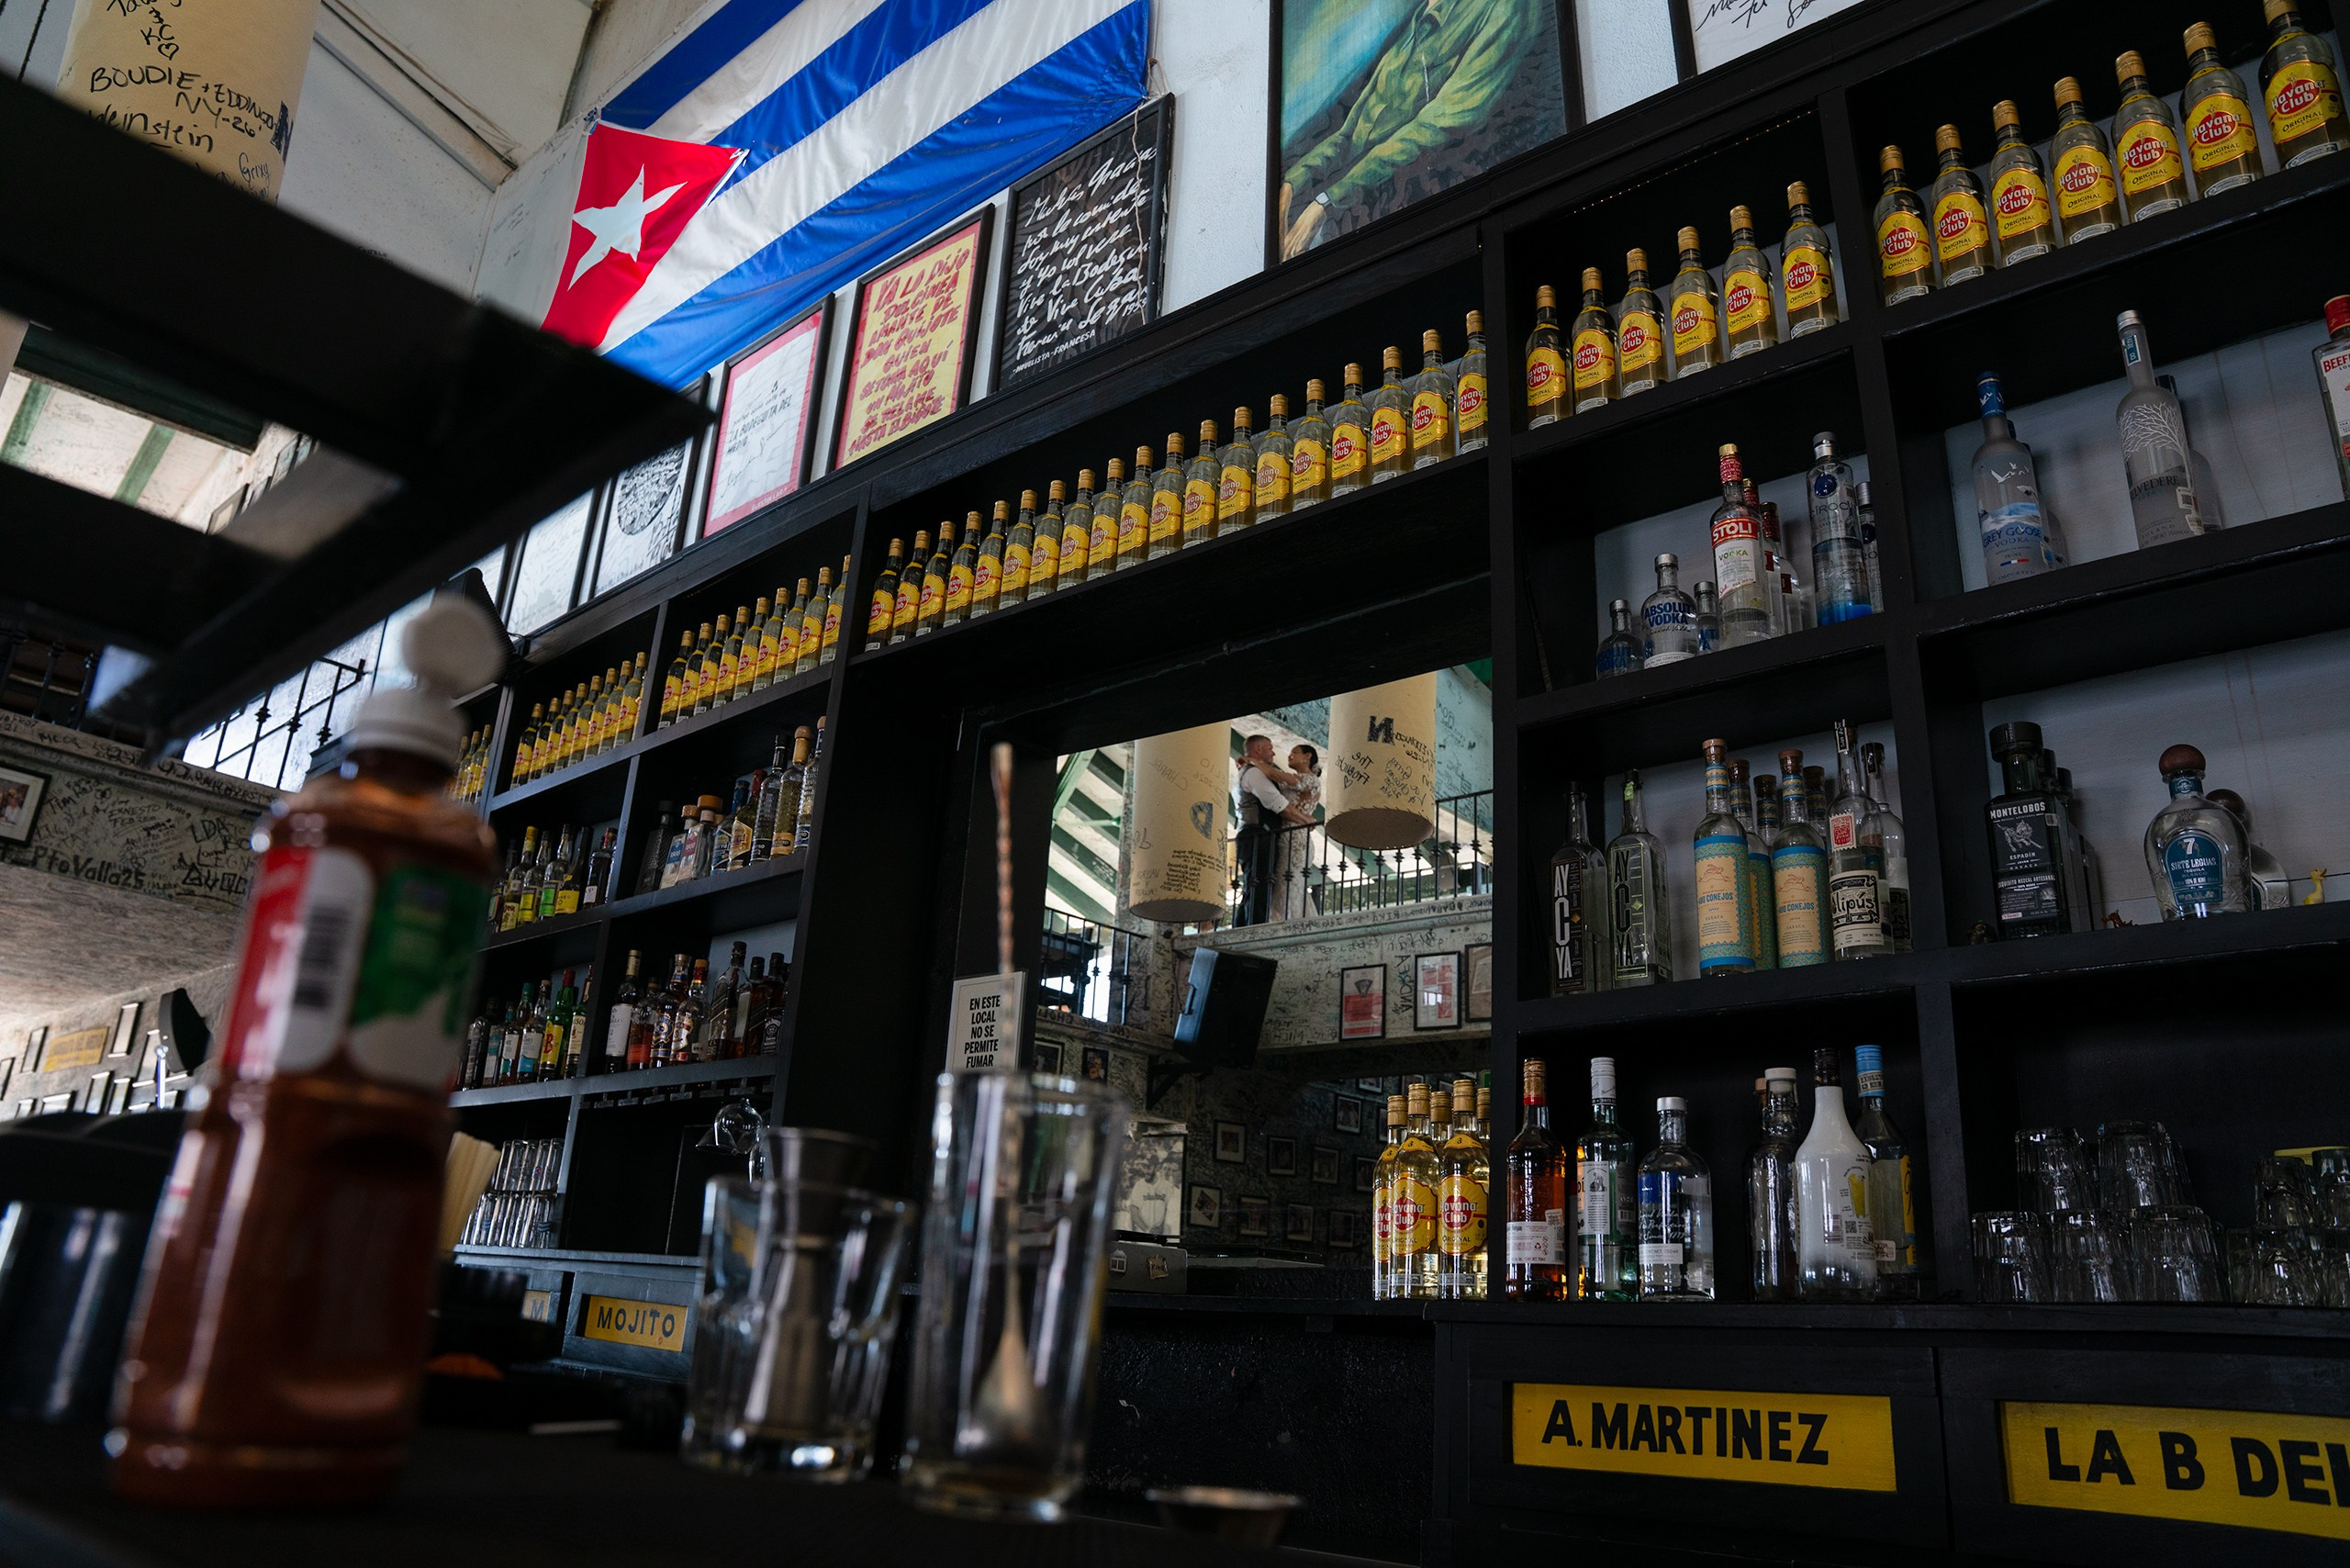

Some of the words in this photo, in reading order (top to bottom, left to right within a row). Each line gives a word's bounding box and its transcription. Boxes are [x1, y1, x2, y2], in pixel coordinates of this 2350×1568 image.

[90, 66, 201, 92] BOUDIE
[2272, 79, 2325, 109] Havana
[2281, 92, 2314, 113] Club
[2192, 113, 2241, 138] Havana
[2201, 124, 2232, 141] Club
[2122, 140, 2168, 162] Havana
[2132, 150, 2160, 166] Club
[2059, 165, 2101, 186] Havana
[2067, 174, 2094, 190] Club
[1997, 187, 2037, 207] Havana
[2003, 196, 2029, 212] Club
[1937, 211, 1974, 230] Havana
[1942, 219, 1965, 236] Club
[1882, 231, 1919, 247] Havana
[1888, 240, 1911, 252] Club
[1790, 274, 1811, 287] Club
[874, 274, 901, 314] YA
[933, 295, 953, 316] DE
[1729, 297, 1749, 310] Club
[1677, 320, 1695, 332] Club
[1623, 337, 1642, 351] Club
[1578, 355, 1596, 367] Club
[1529, 373, 1546, 386] Club
[1460, 390, 1483, 403] avana
[1414, 408, 1436, 420] avana
[1372, 424, 1395, 437] avana
[1333, 441, 1356, 453] avana
[1713, 522, 1752, 542] STOLI
[1983, 530, 2004, 547] GREY
[2006, 525, 2042, 537] GOOSE
[1995, 537, 2030, 547] VODKA
[1718, 550, 1748, 561] VODKA
[1644, 601, 1691, 620] ABSOLUT
[1649, 613, 1688, 628] VODKA
[1989, 801, 2046, 820] MONTELOBOS
[2183, 837, 2195, 855] 7
[2171, 860, 2189, 870] SIETE
[2190, 857, 2216, 868] LEGUAS
[1707, 892, 1733, 902] CONEJOS
[1787, 902, 1814, 912] CONEJOS
[969, 998, 980, 1011] EN
[981, 995, 1001, 1009] ESTE
[971, 1010, 996, 1025] LOCAL
[970, 1026, 983, 1039] NO
[984, 1025, 995, 1037] SE
[965, 1039, 999, 1055] PERMITE
[966, 1054, 994, 1069] FUMAR
[1393, 1202, 1425, 1213] avana
[1443, 1212, 1468, 1223] Club
[597, 1305, 676, 1338] MOJITO
[1541, 1399, 1583, 1448] A.
[1591, 1403, 1830, 1466] MARTINEZ
[2043, 1426, 2136, 1487] LA
[2163, 1431, 2207, 1492] B
